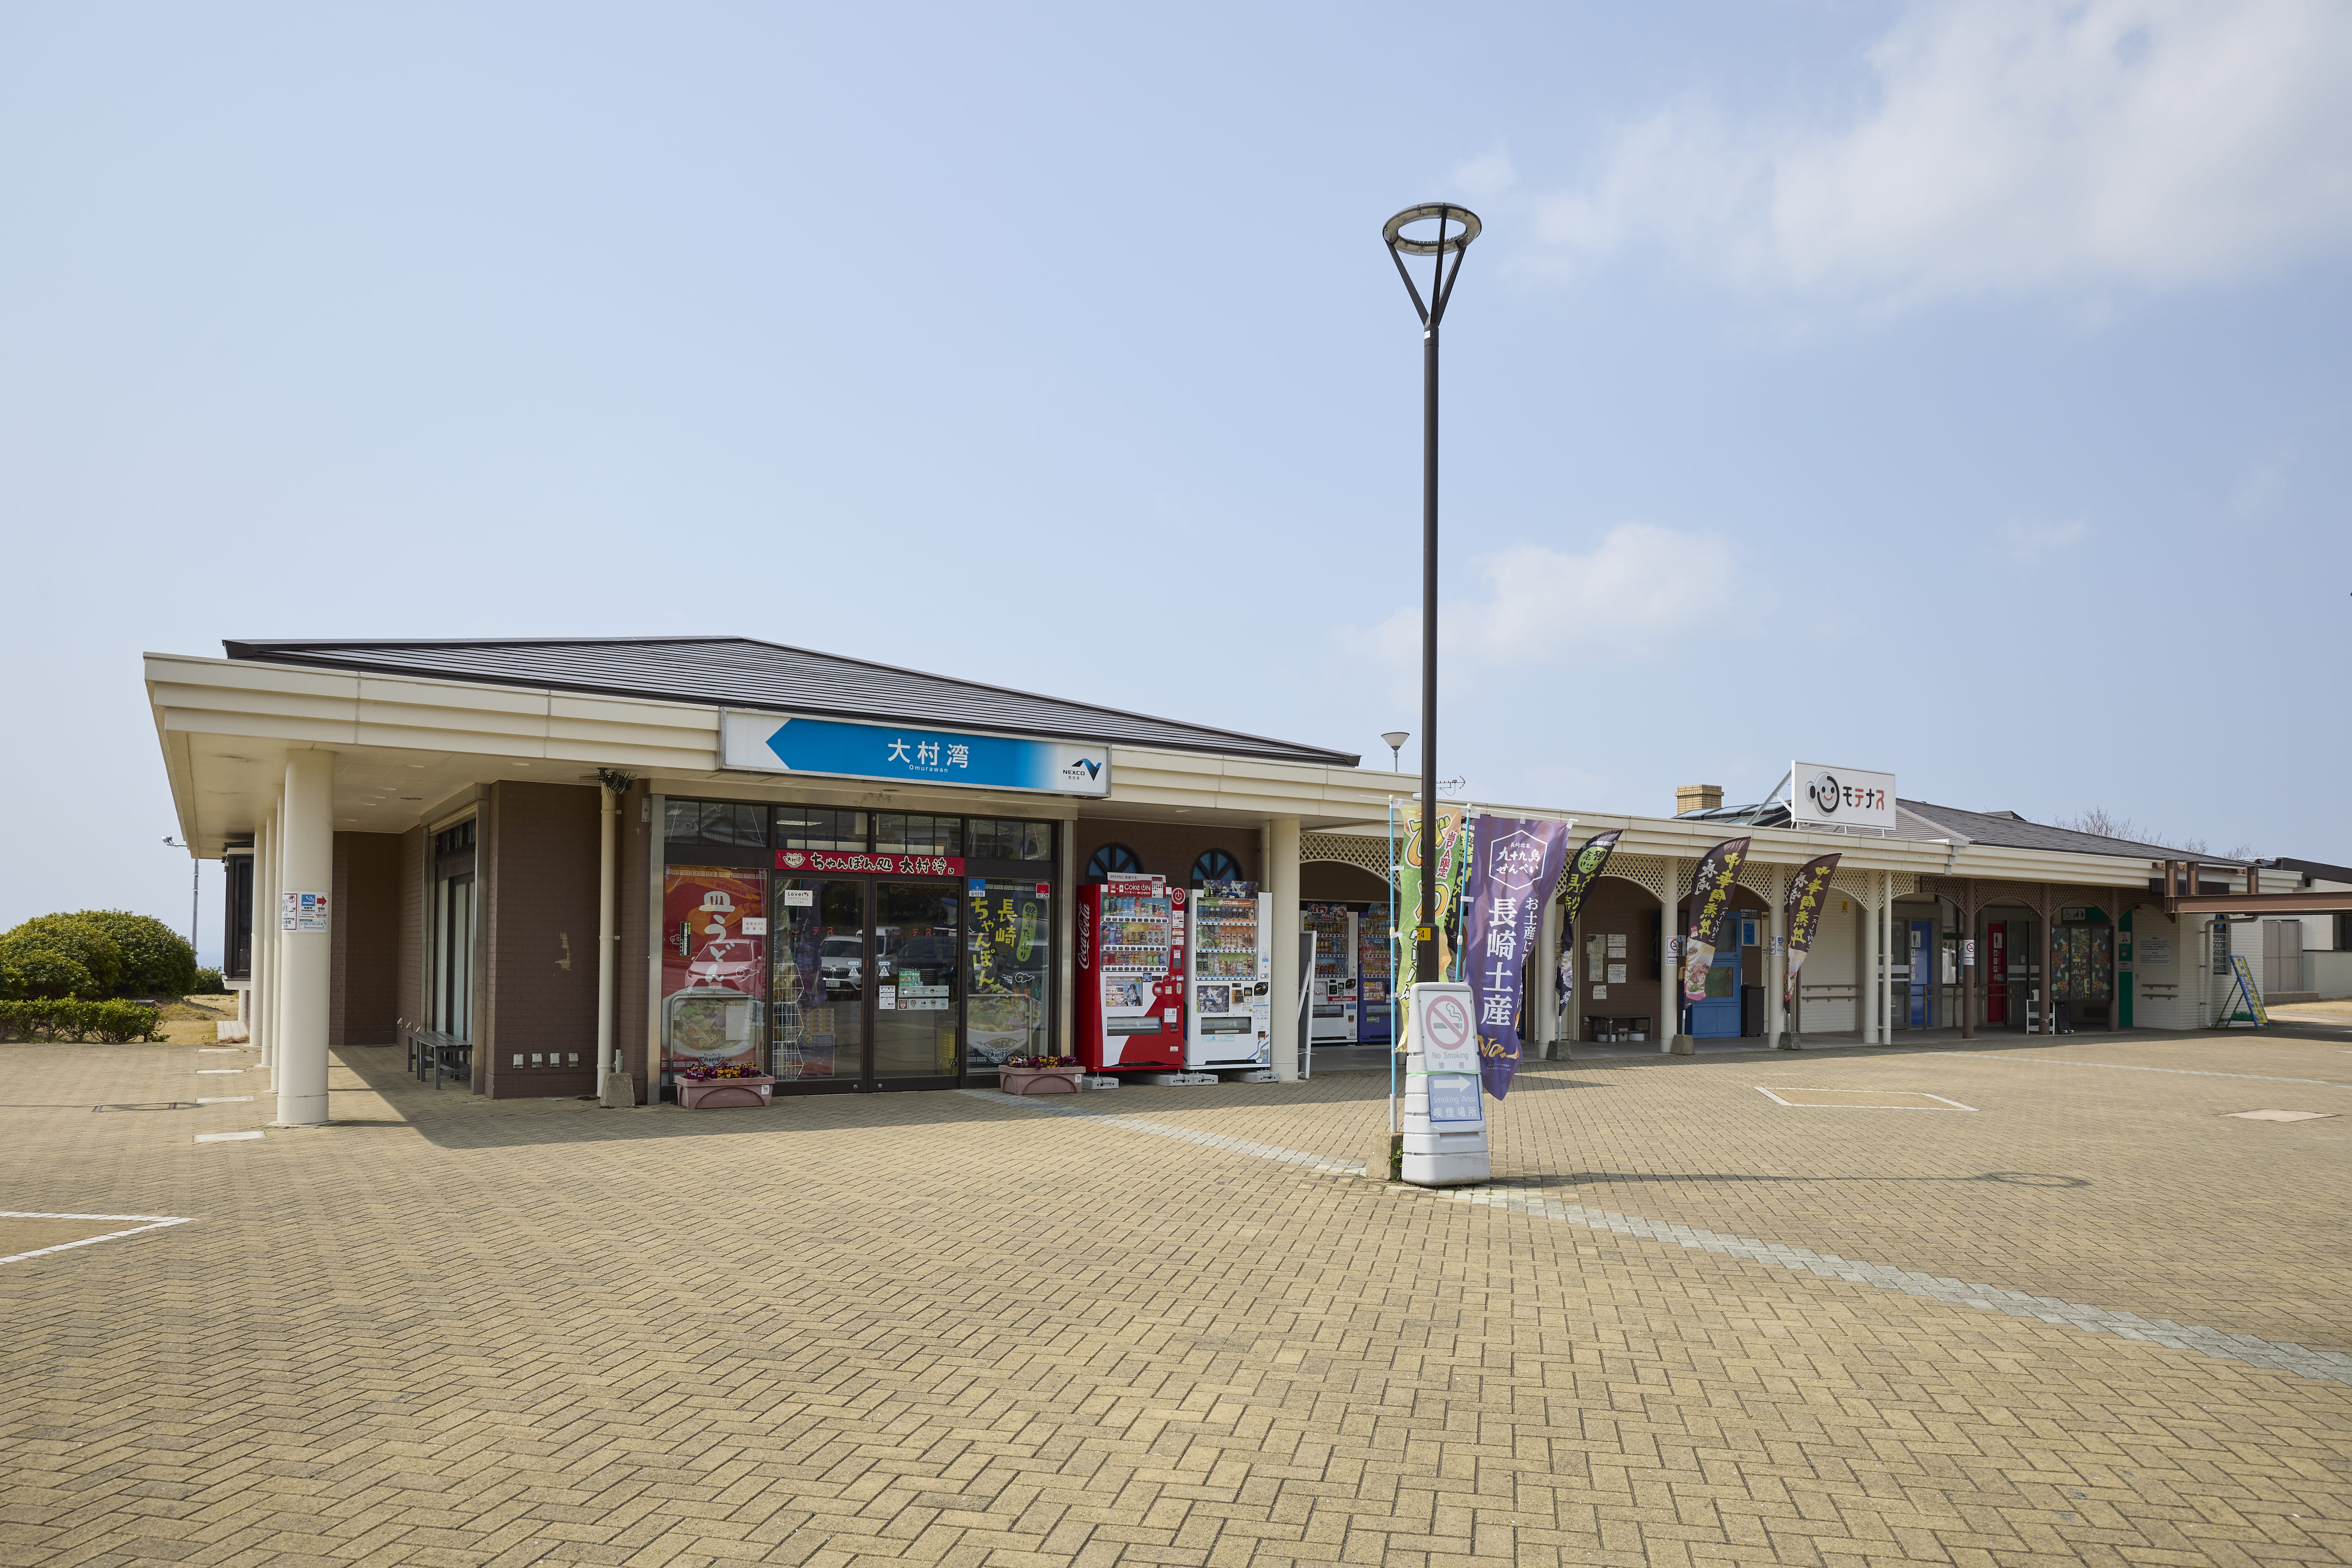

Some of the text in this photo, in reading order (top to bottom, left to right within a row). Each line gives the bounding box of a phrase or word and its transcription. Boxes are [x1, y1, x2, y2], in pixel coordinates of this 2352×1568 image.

[887, 739, 969, 768] 大村湾
[1843, 786, 1884, 810] モテナス
[811, 852, 946, 875] ちゃんぽん処 大村湾
[1437, 831, 1456, 878] 当PA限定
[1496, 846, 1540, 862] 九十九島
[1496, 863, 1539, 875] せんぺい
[1312, 904, 1328, 914] Try
[995, 898, 1018, 948] 長崎
[1021, 905, 1036, 959] 野菜たっぷり
[1078, 900, 1090, 969] Coca-Cola
[699, 891, 735, 982] 皿うどん
[970, 897, 995, 987] ちゃんぽん
[1481, 897, 1518, 1026] 長崎土産
[1444, 1052, 1469, 1060] Smoking
[1433, 1096, 1459, 1104] Smoking
[1433, 1107, 1476, 1118] 喫煙場所
